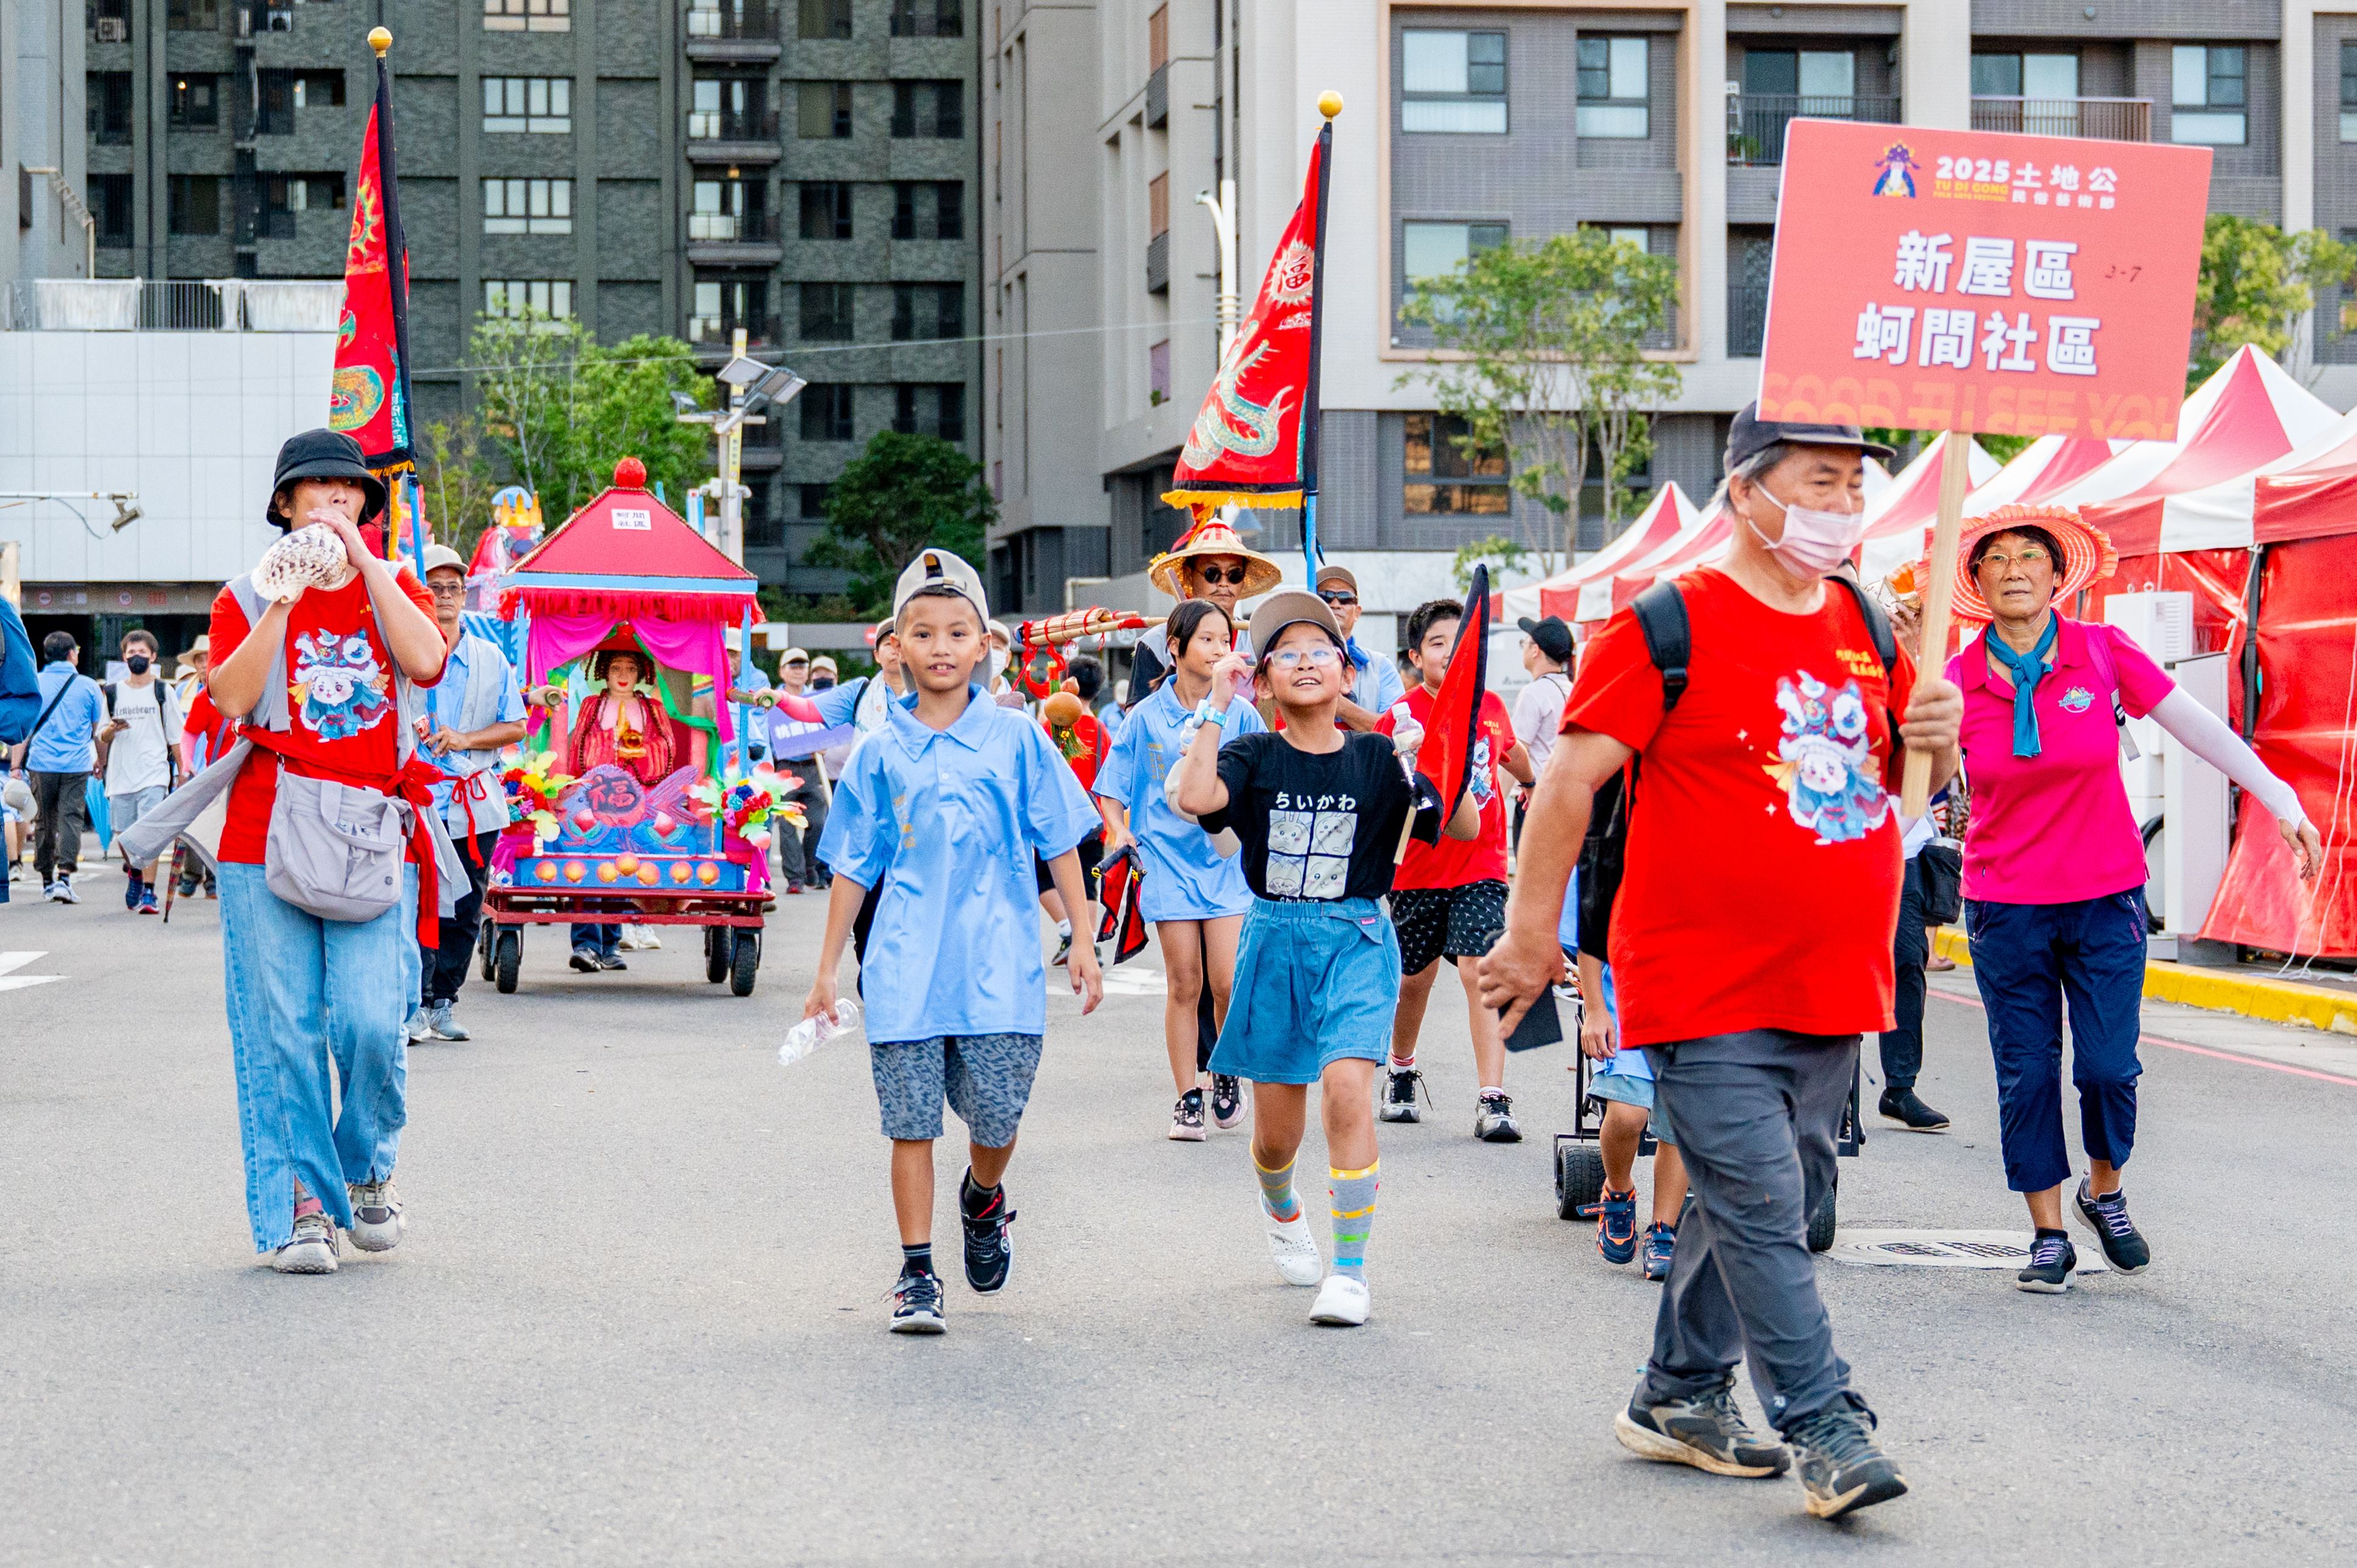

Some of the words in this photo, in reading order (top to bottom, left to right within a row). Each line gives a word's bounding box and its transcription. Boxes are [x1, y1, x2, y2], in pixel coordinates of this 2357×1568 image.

[1936, 155, 2010, 183] 2025
[2012, 161, 2118, 193] 土地公
[1277, 254, 1312, 294] 福
[1893, 229, 2078, 301] 新屋區
[1852, 301, 2101, 376] 蚵間社區
[586, 773, 636, 810] 福
[1276, 791, 1357, 812] ちいかわ
